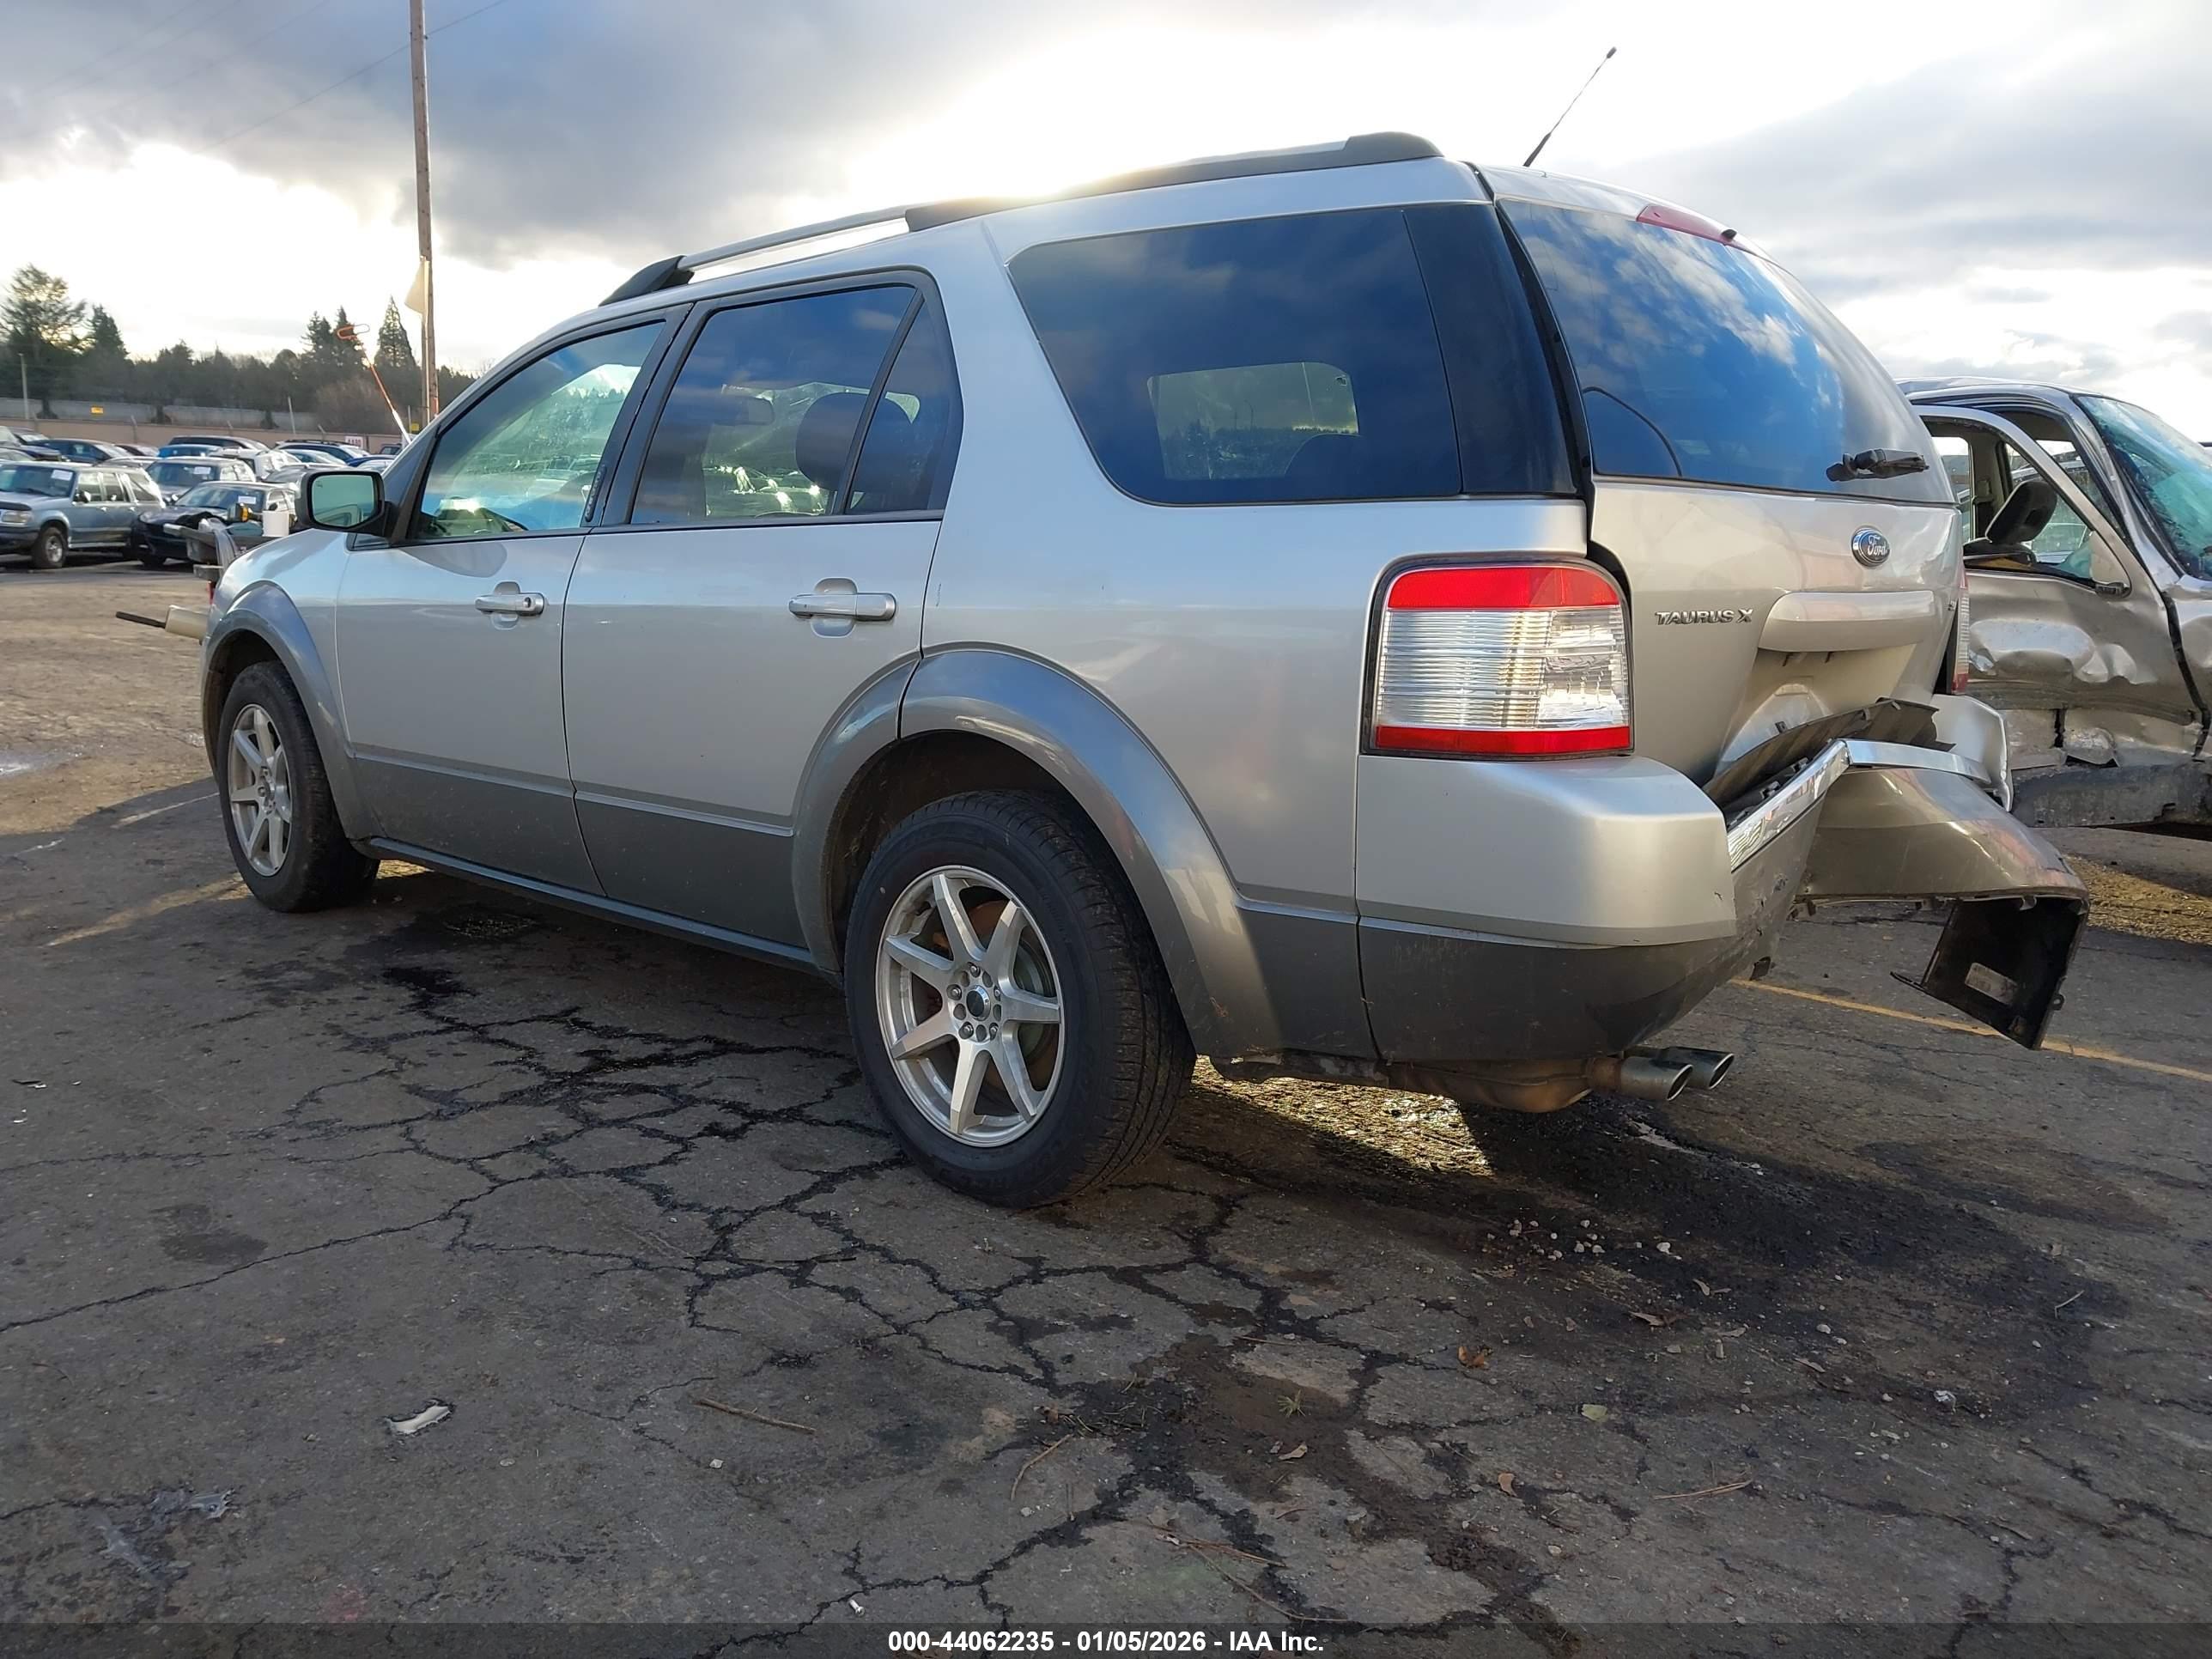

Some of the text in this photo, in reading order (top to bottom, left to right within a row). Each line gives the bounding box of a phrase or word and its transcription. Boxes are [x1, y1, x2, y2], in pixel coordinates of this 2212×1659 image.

[1868, 534, 1888, 556] Ford
[1655, 608, 1753, 625] TAURUS X
